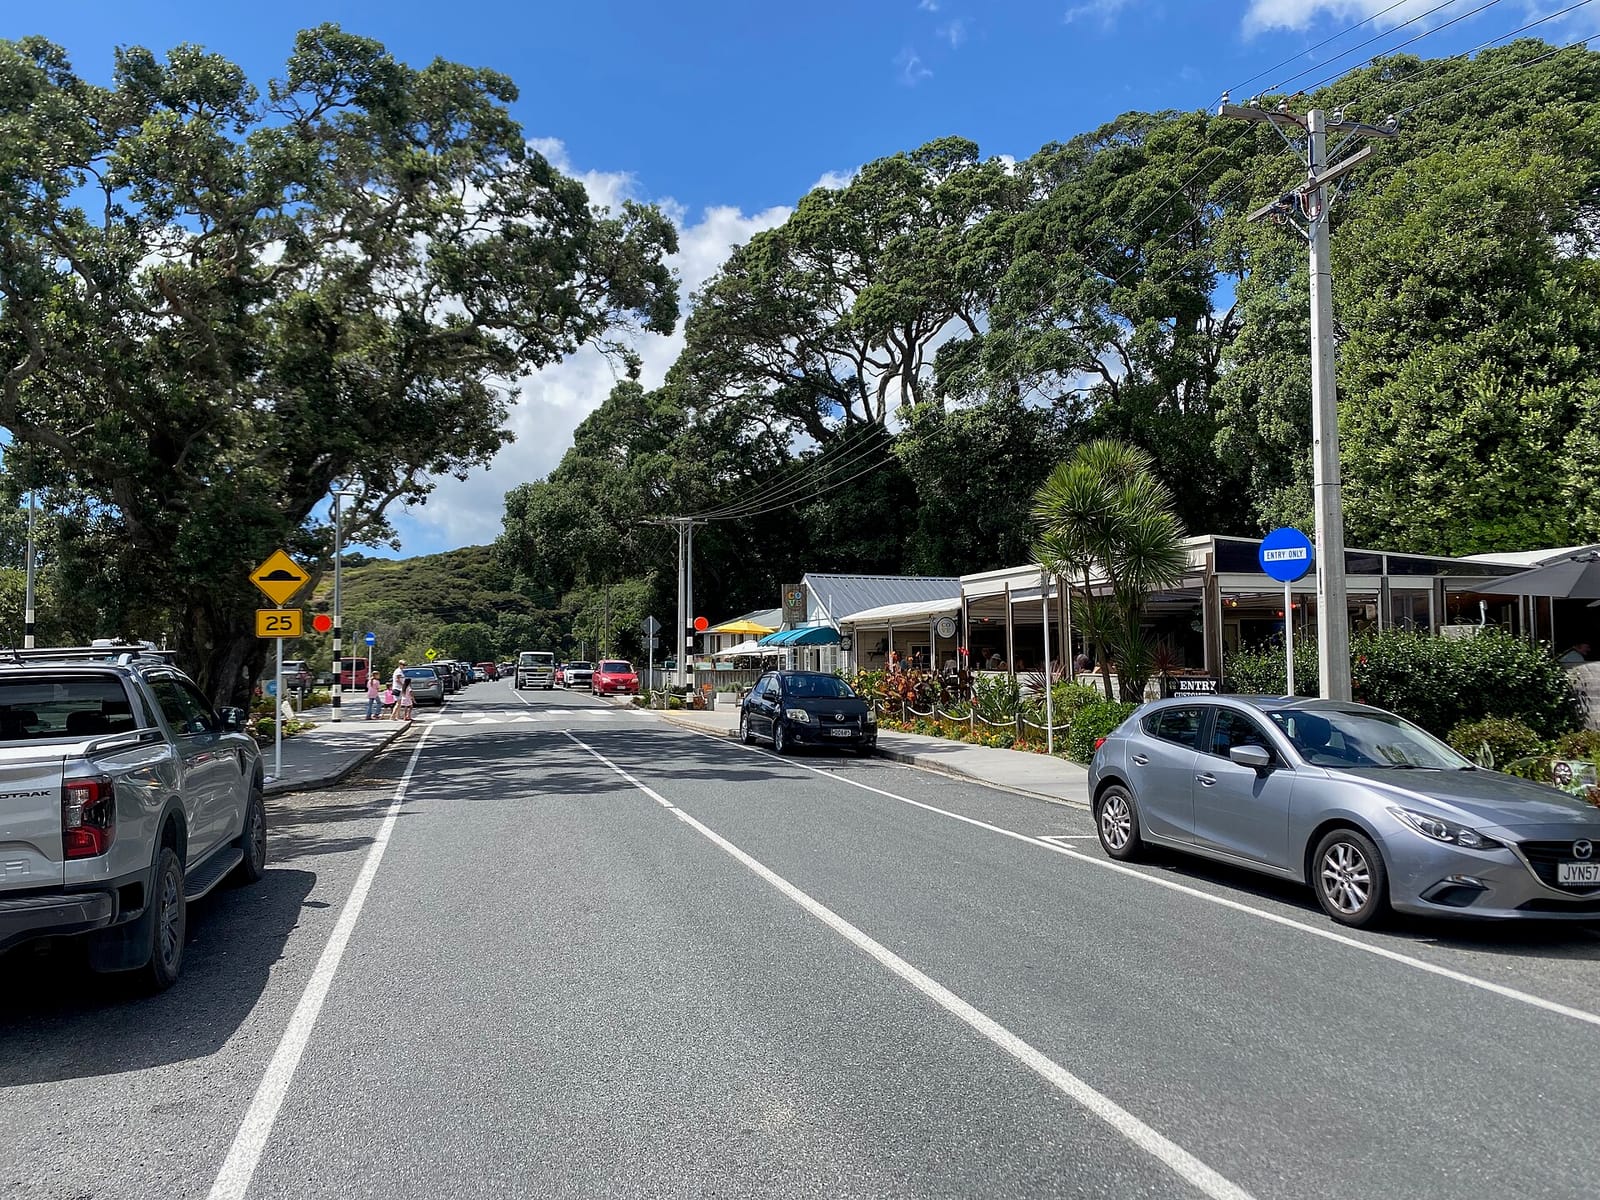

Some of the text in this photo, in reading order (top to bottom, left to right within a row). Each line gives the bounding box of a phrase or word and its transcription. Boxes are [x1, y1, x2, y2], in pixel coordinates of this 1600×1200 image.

[1266, 549, 1304, 560] ENTRY ONLY
[266, 615, 292, 630] 25
[1180, 680, 1217, 690] ENTRY
[1564, 866, 1599, 880] JYN57
